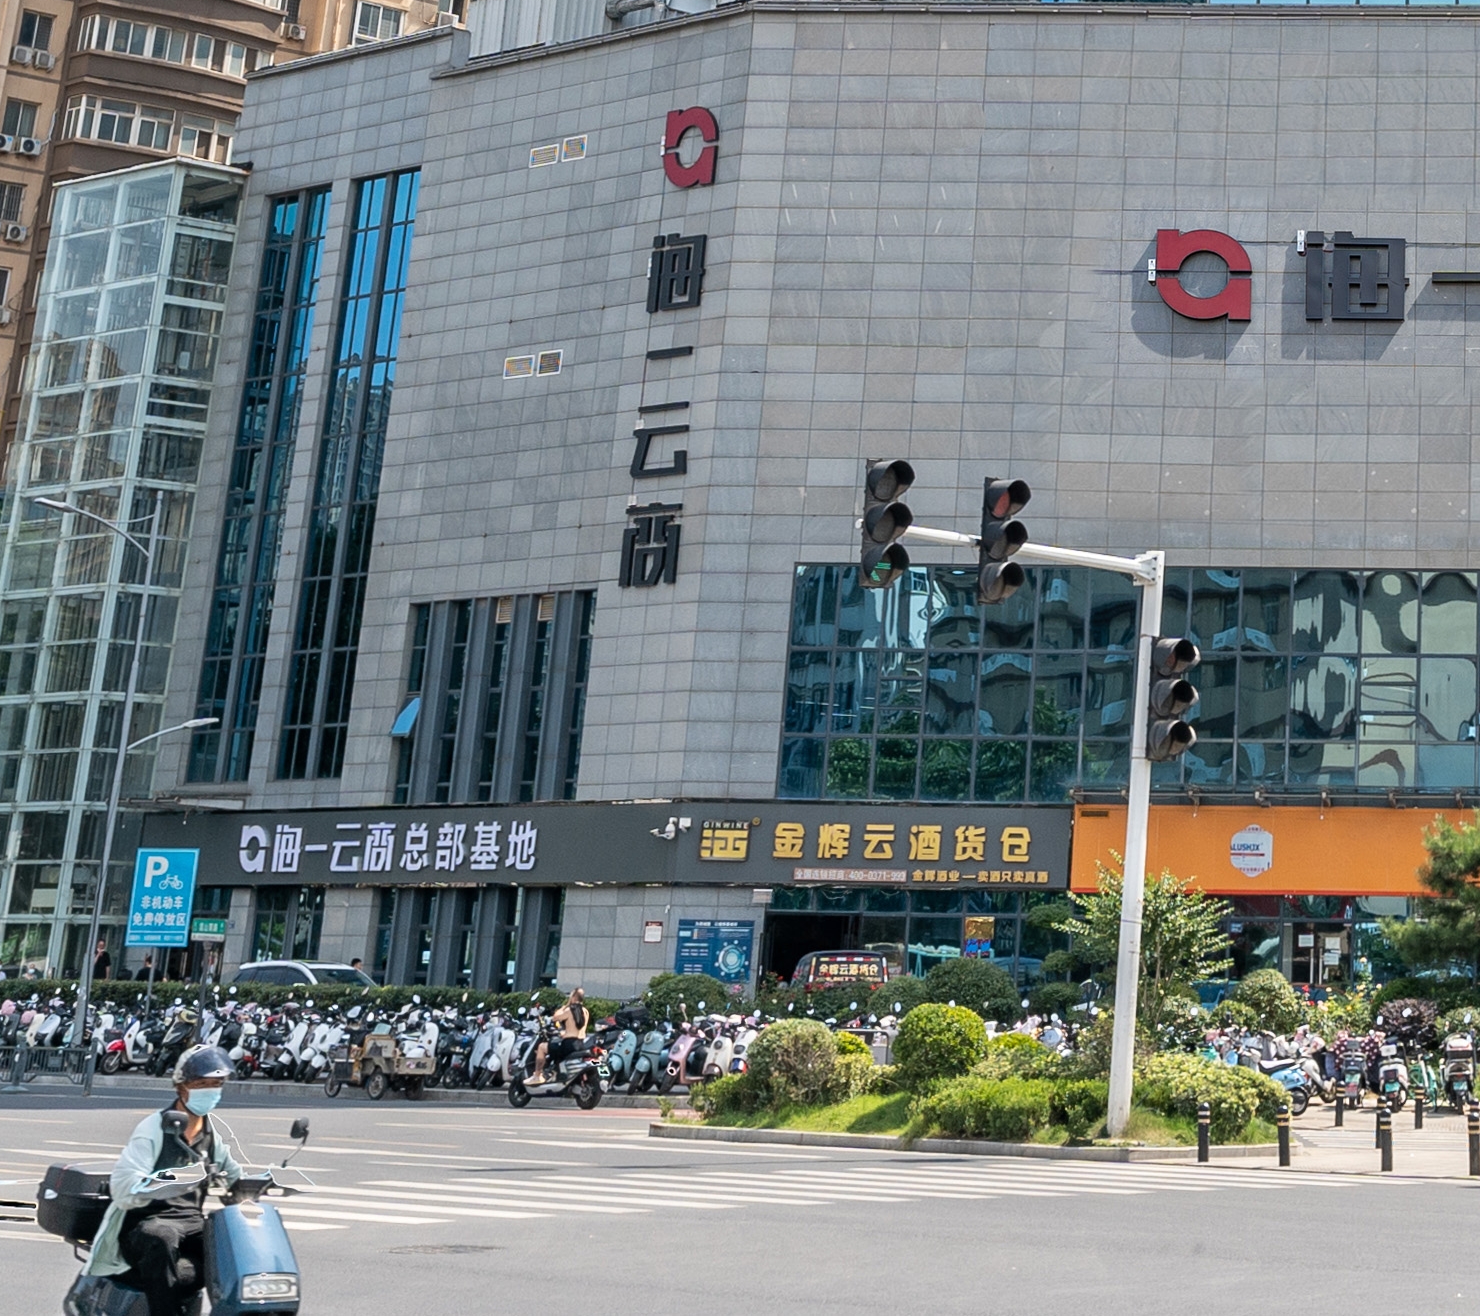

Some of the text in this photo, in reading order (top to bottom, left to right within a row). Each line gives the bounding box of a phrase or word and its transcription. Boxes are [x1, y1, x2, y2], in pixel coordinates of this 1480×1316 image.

[618, 232, 708, 589] 海一云商
[702, 821, 750, 830] GINWINE
[271, 820, 538, 873] 海一云商总部基地
[772, 822, 1032, 864] 金辉云酒货仓
[143, 855, 170, 888] P
[140, 895, 184, 910] 非机动车
[131, 912, 187, 927] 免费停放区
